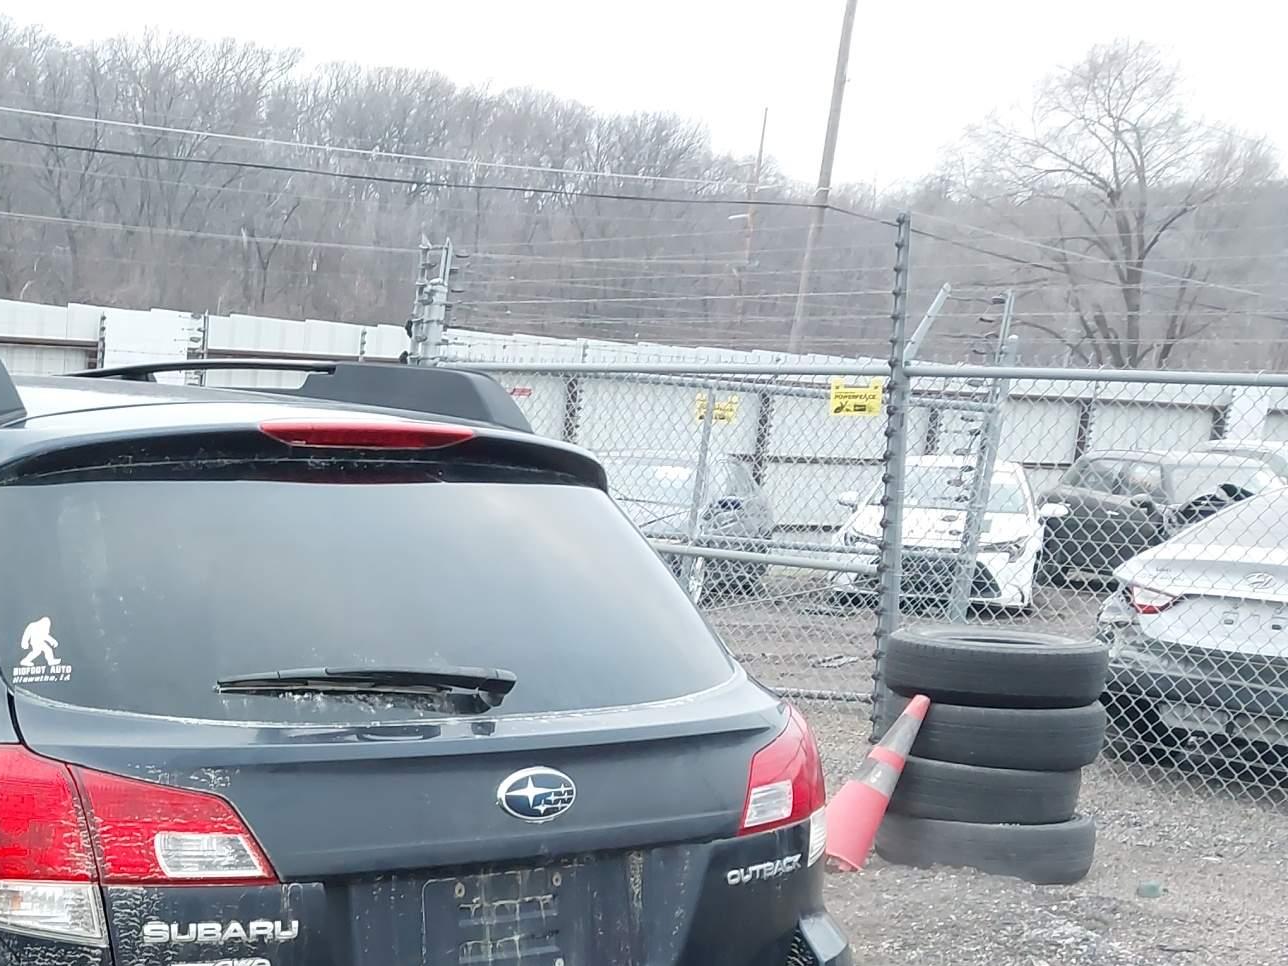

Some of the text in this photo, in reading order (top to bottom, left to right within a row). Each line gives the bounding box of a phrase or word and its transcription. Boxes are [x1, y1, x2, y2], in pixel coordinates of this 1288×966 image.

[13, 665, 72, 676] BIGFOOT AUTO
[727, 853, 802, 885] OUTBACK
[142, 920, 299, 943] SUBARU
